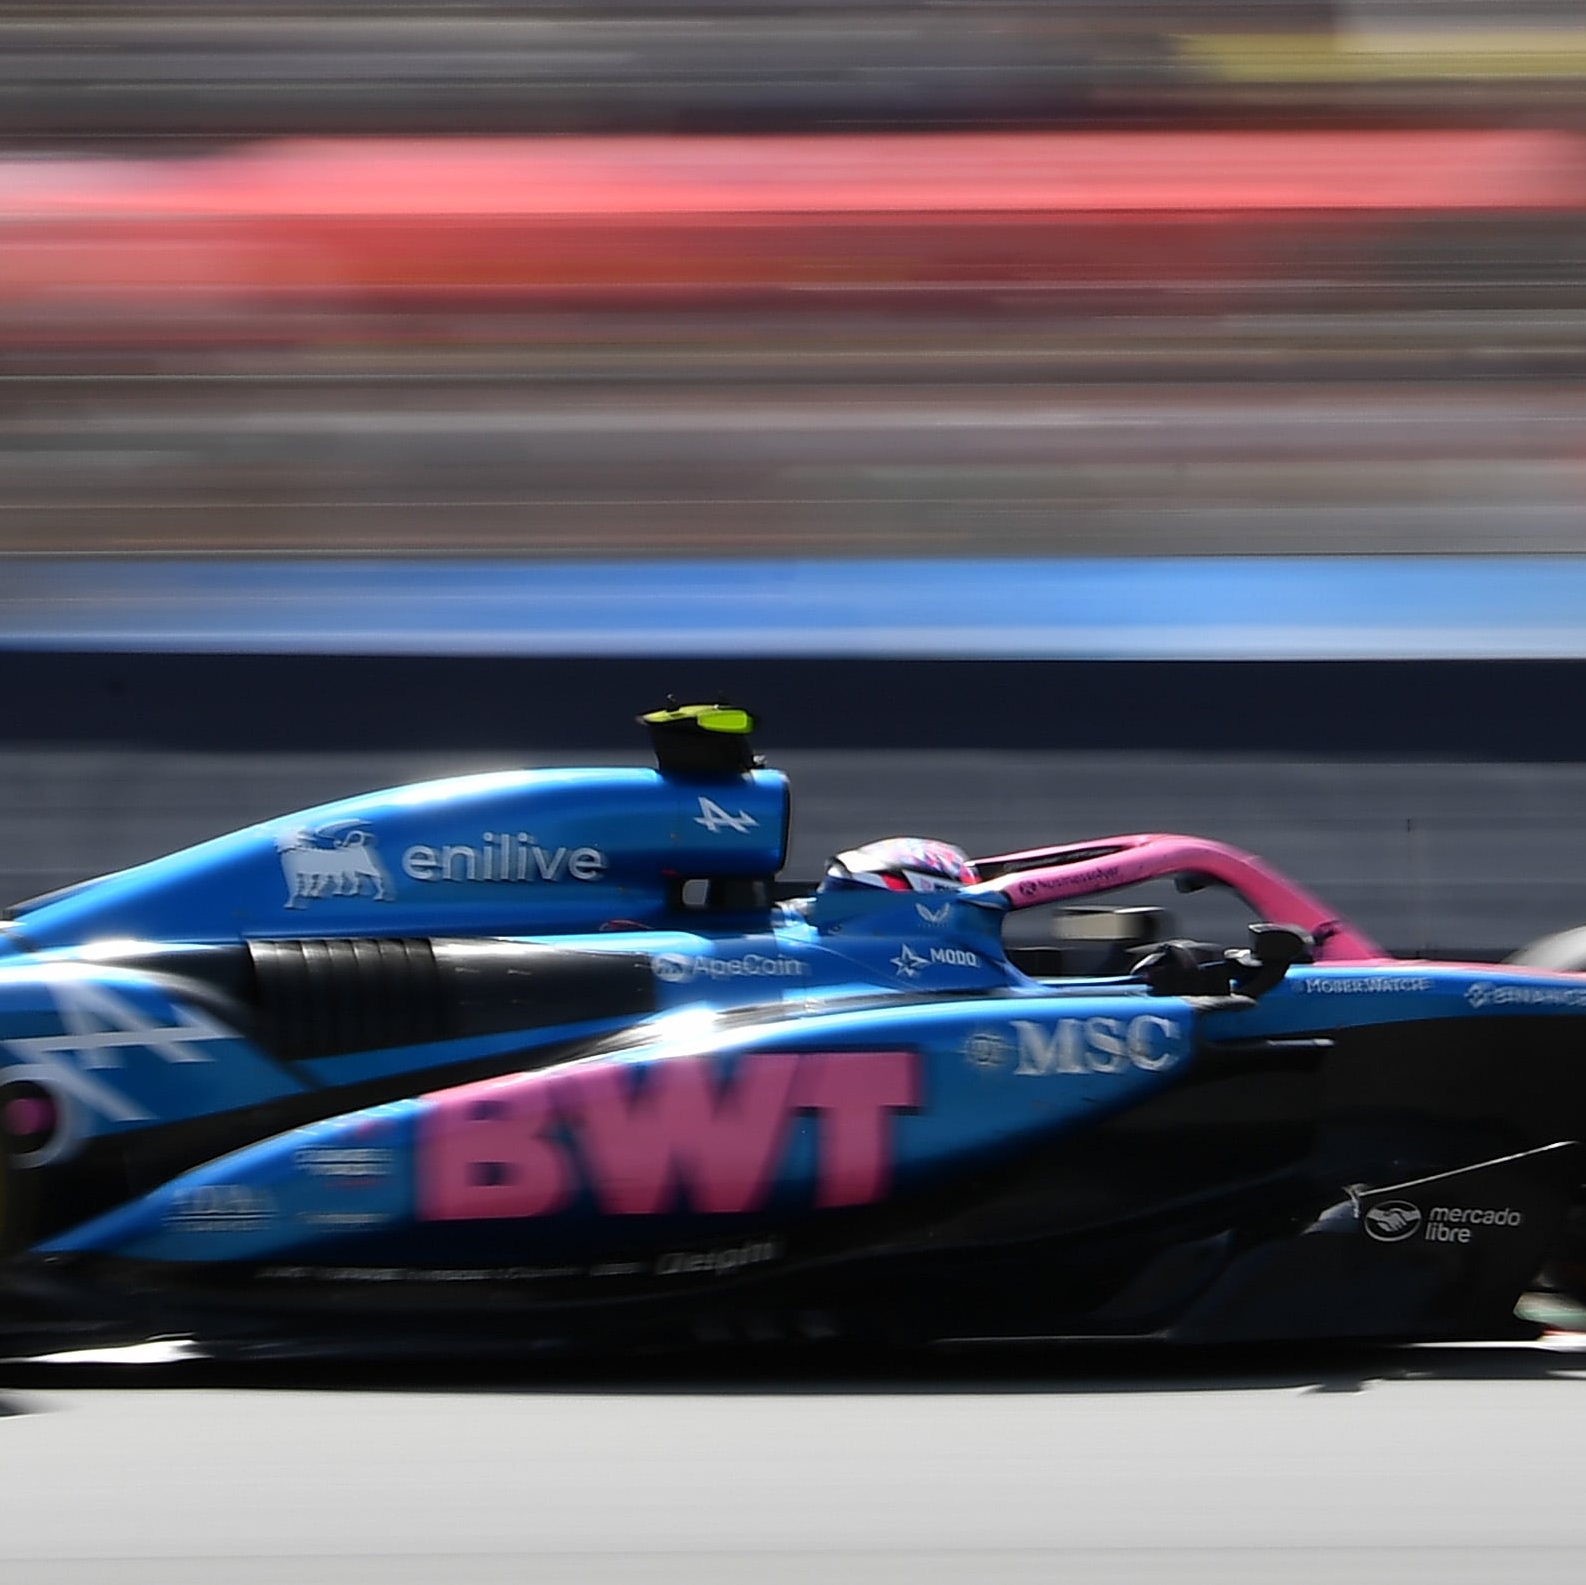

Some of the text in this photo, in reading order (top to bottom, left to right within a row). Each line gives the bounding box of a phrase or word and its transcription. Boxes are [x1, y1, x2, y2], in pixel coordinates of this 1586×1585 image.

[402, 831, 606, 881] enilive
[692, 954, 805, 981] ApeCoin
[930, 947, 981, 968] MODO
[1008, 1014, 1183, 1076] MSC
[419, 1051, 925, 1222] BWT
[1429, 1206, 1522, 1227] mercado
[1424, 1221, 1472, 1244] libre
